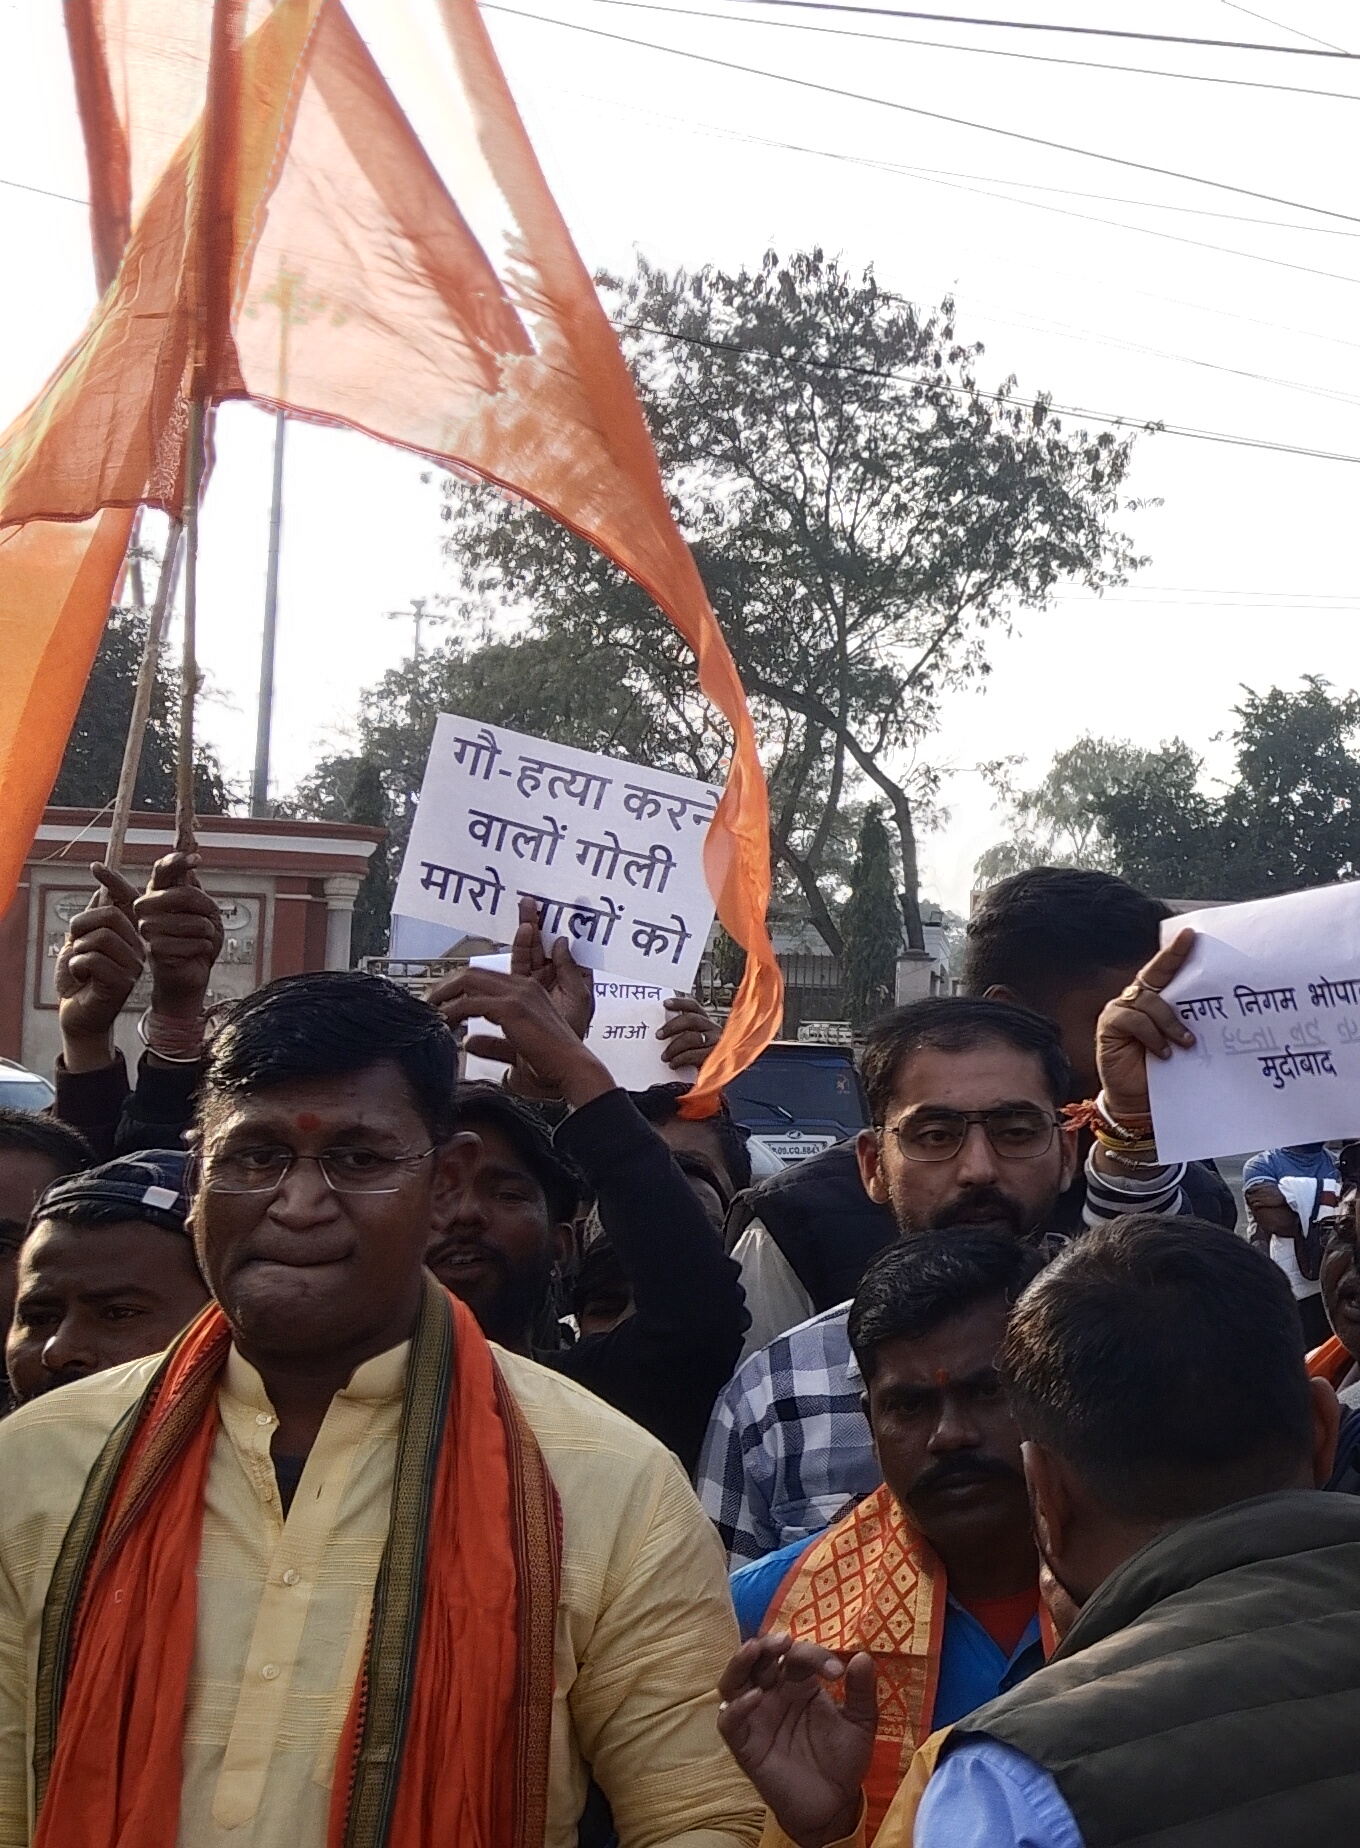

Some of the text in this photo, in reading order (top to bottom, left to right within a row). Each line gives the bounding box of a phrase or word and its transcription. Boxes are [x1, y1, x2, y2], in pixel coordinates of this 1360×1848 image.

[453, 728, 613, 811] गौ-हत्या
[468, 808, 677, 894] वालों गोली
[420, 861, 693, 965] मारो ालों को
[593, 982, 662, 1001] प्रशासन
[1176, 995, 1230, 1022] नगर
[1233, 984, 1299, 1017] निगम
[602, 1019, 650, 1040] आओ
[1256, 1044, 1338, 1090] मुर्दाबाद
